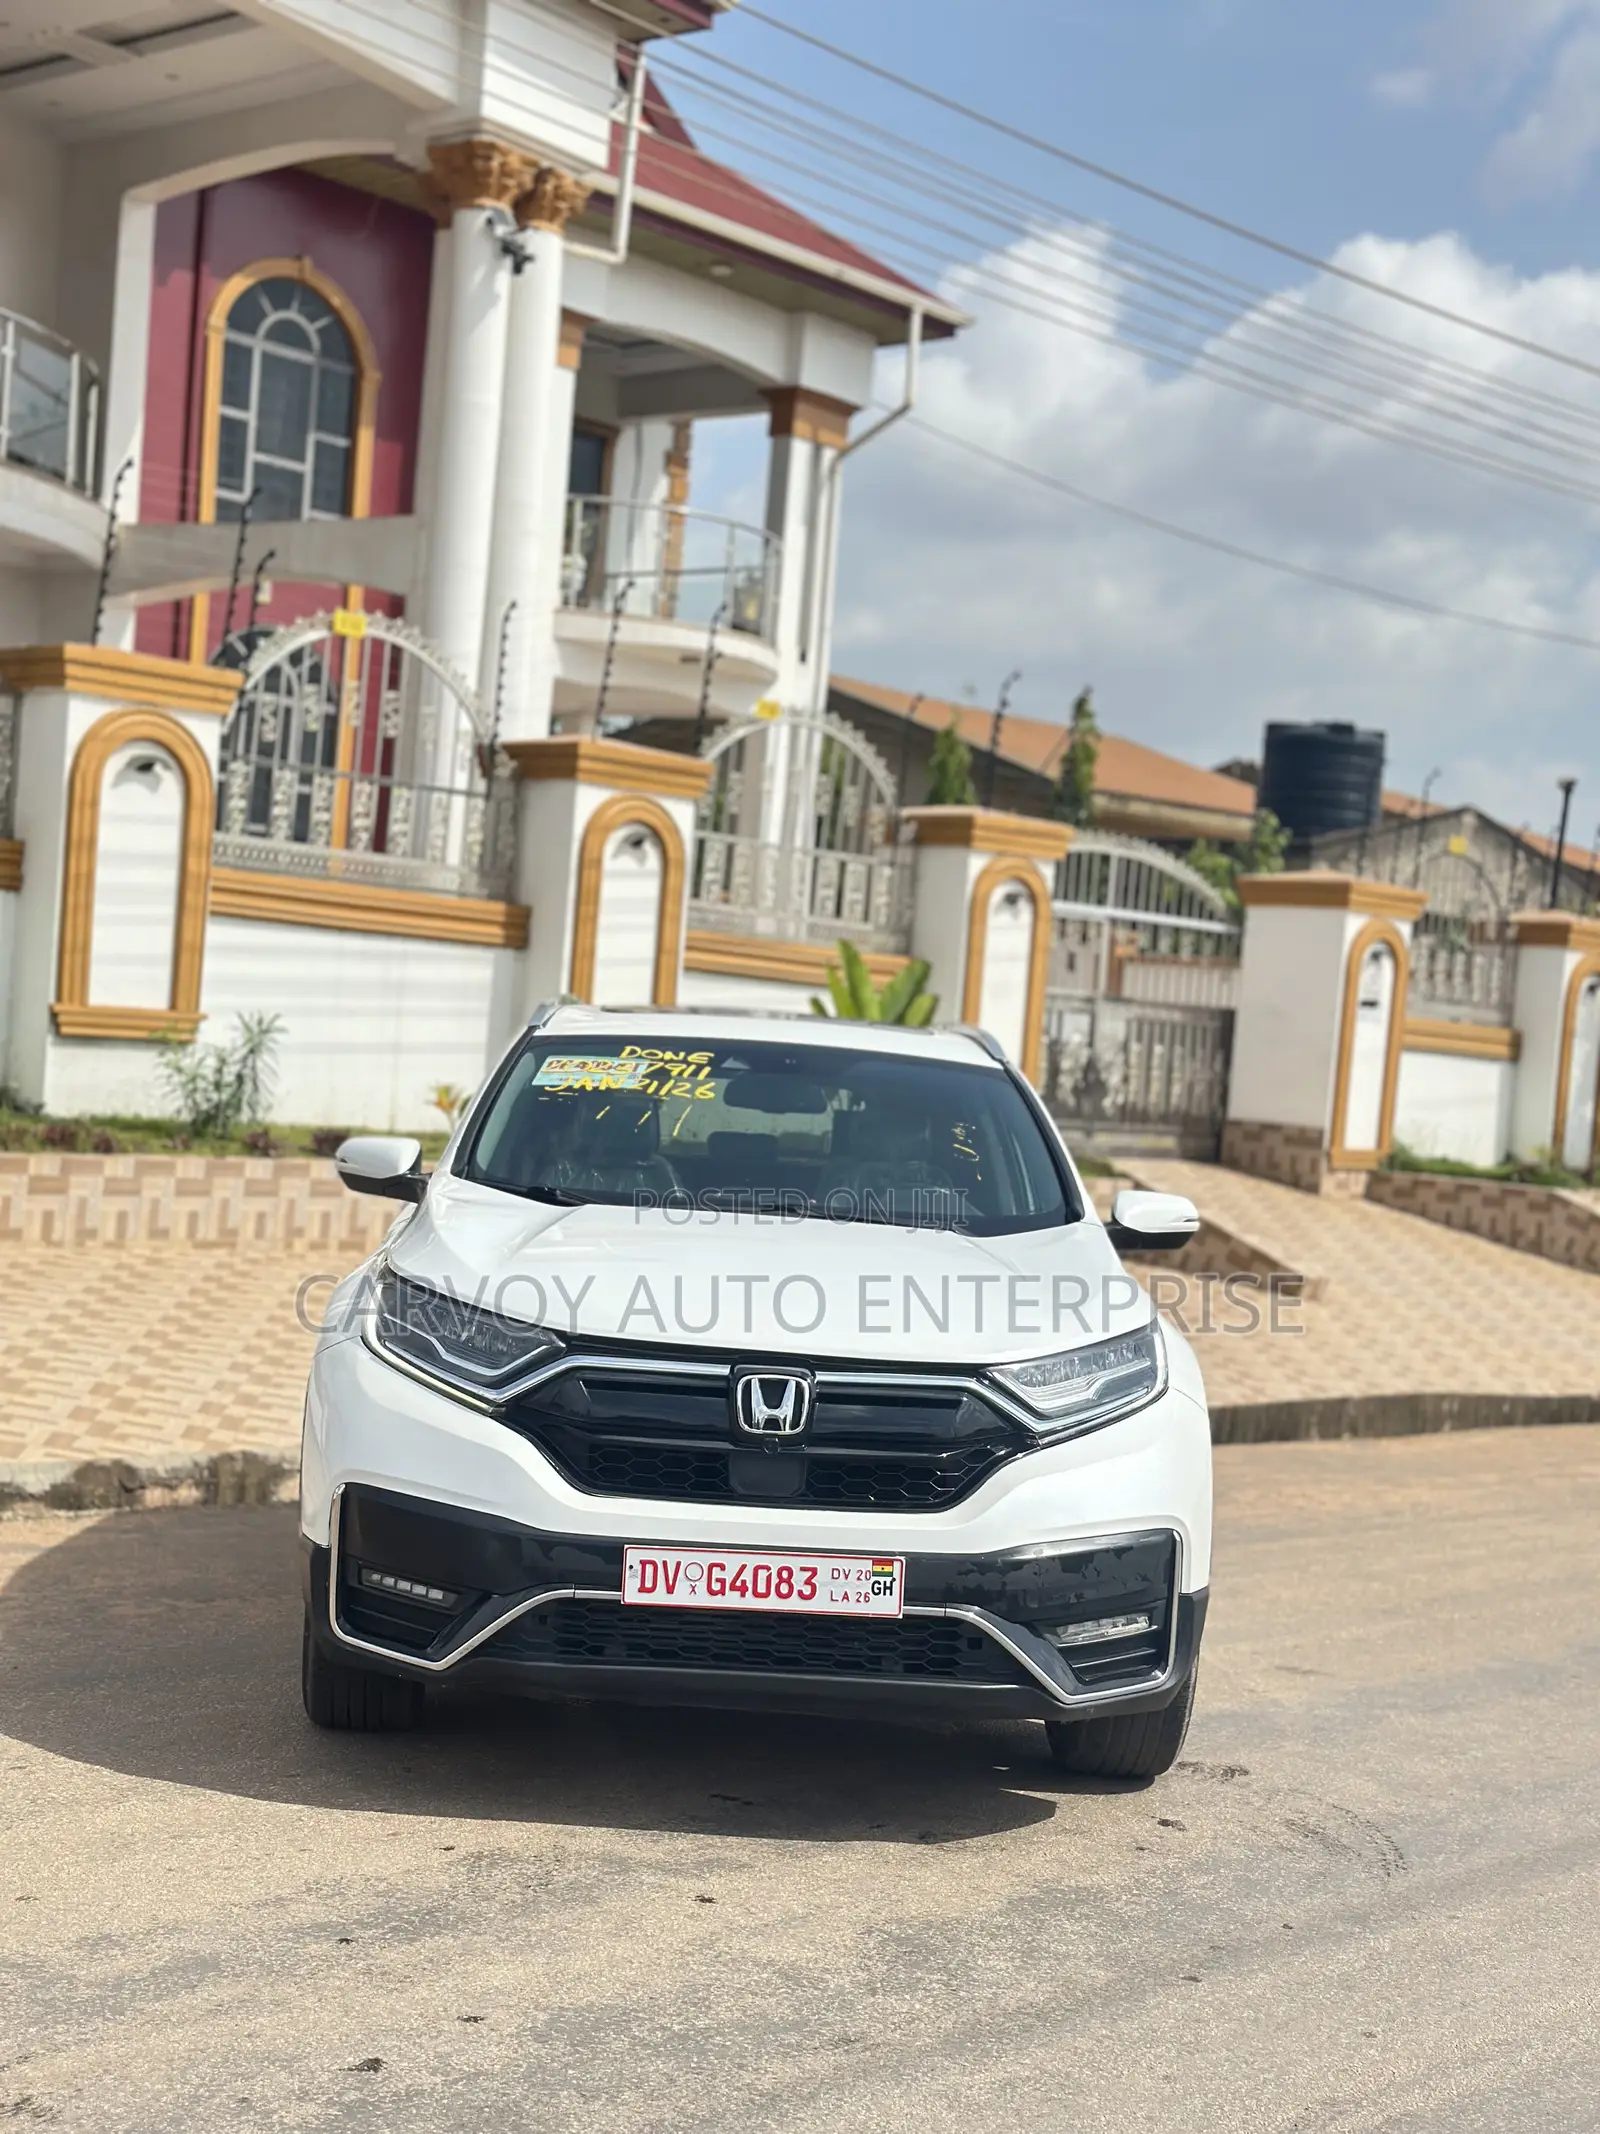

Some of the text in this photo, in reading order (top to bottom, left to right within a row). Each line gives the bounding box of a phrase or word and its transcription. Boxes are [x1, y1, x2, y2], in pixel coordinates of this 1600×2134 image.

[619, 1046, 715, 1064] DONE
[544, 1075, 625, 1091] JAN
[638, 1559, 819, 1601] DV G4083
[831, 1567, 872, 1582] DV 20
[830, 1589, 871, 1603] LA 26
[871, 1580, 894, 1597] GH
